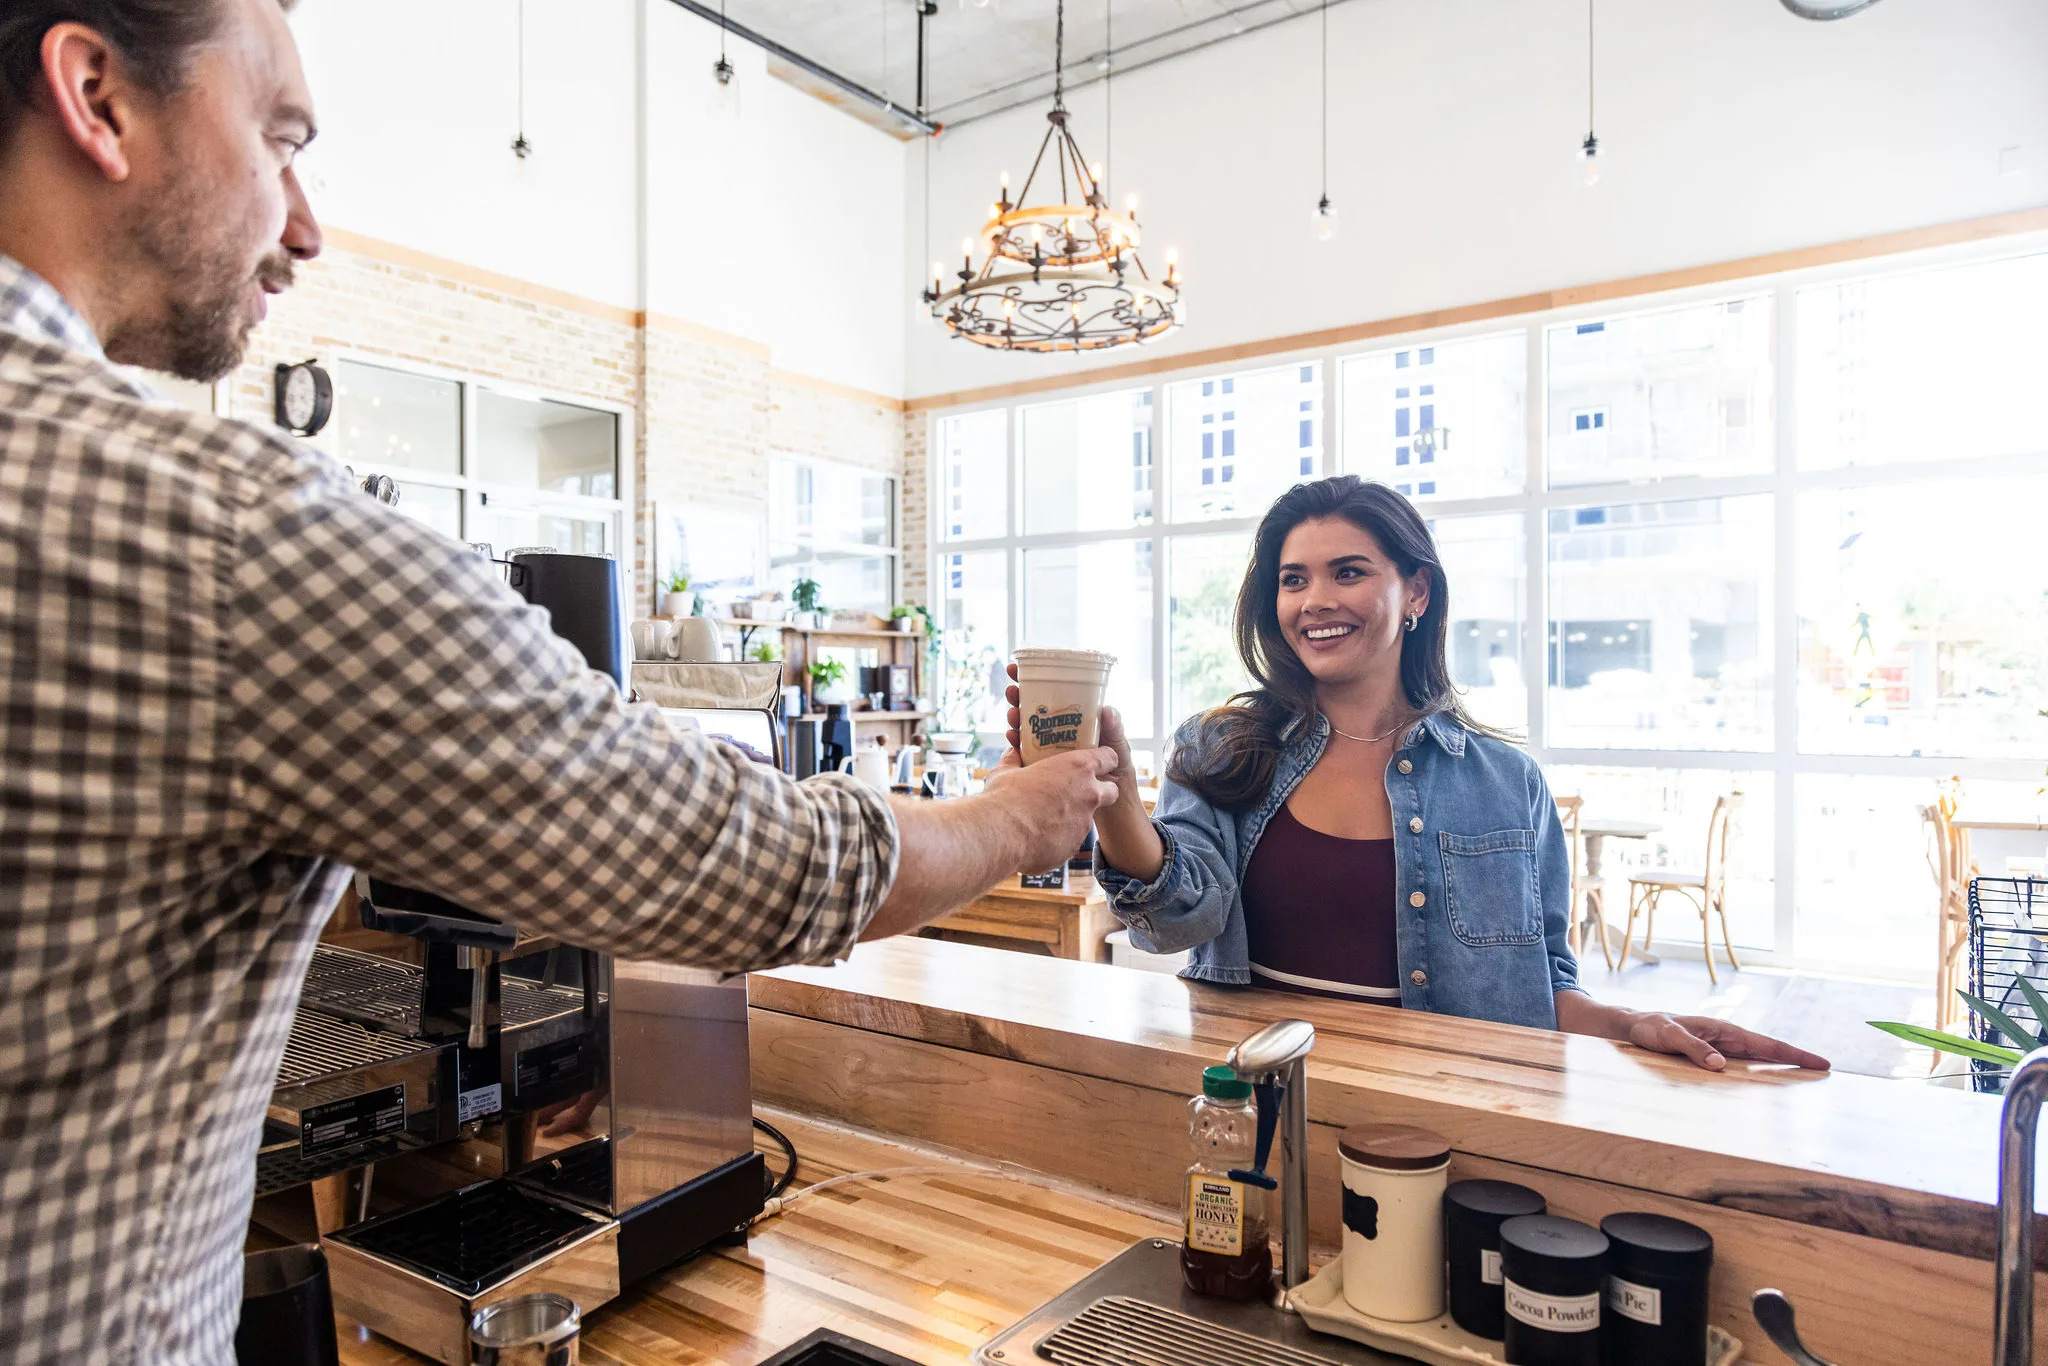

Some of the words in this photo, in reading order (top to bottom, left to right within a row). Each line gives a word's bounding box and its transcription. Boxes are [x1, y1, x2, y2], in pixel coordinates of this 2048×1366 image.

[1029, 713, 1082, 734] BROTHERS
[1036, 729, 1078, 746] THOMAS
[1199, 1193, 1234, 1206] ORGANIC
[1195, 1208, 1237, 1224] HONEY
[1508, 1292, 1544, 1318] Cocoa
[1547, 1305, 1596, 1322] Powder
